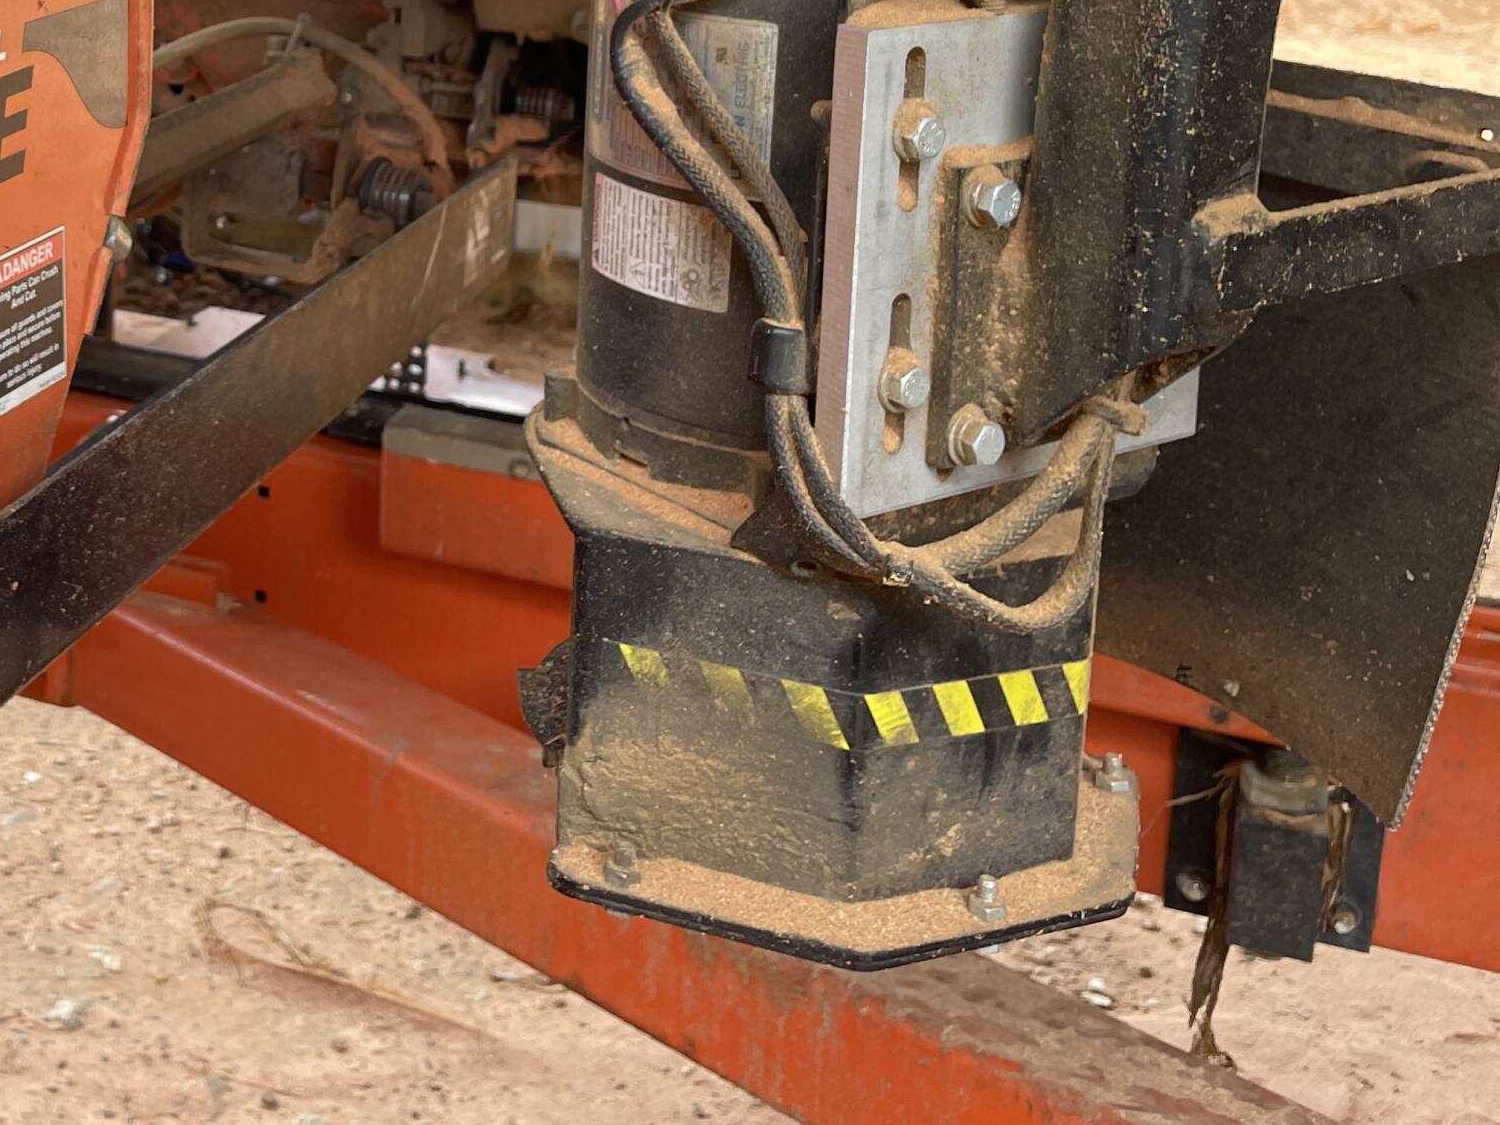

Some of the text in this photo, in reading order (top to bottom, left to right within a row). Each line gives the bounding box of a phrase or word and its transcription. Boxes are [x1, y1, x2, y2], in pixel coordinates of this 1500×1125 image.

[2, 241, 54, 281] DANGER
[12, 279, 28, 295] Parts
[28, 273, 41, 287] Can
[41, 265, 59, 282] Crush
[11, 297, 25, 309] And
